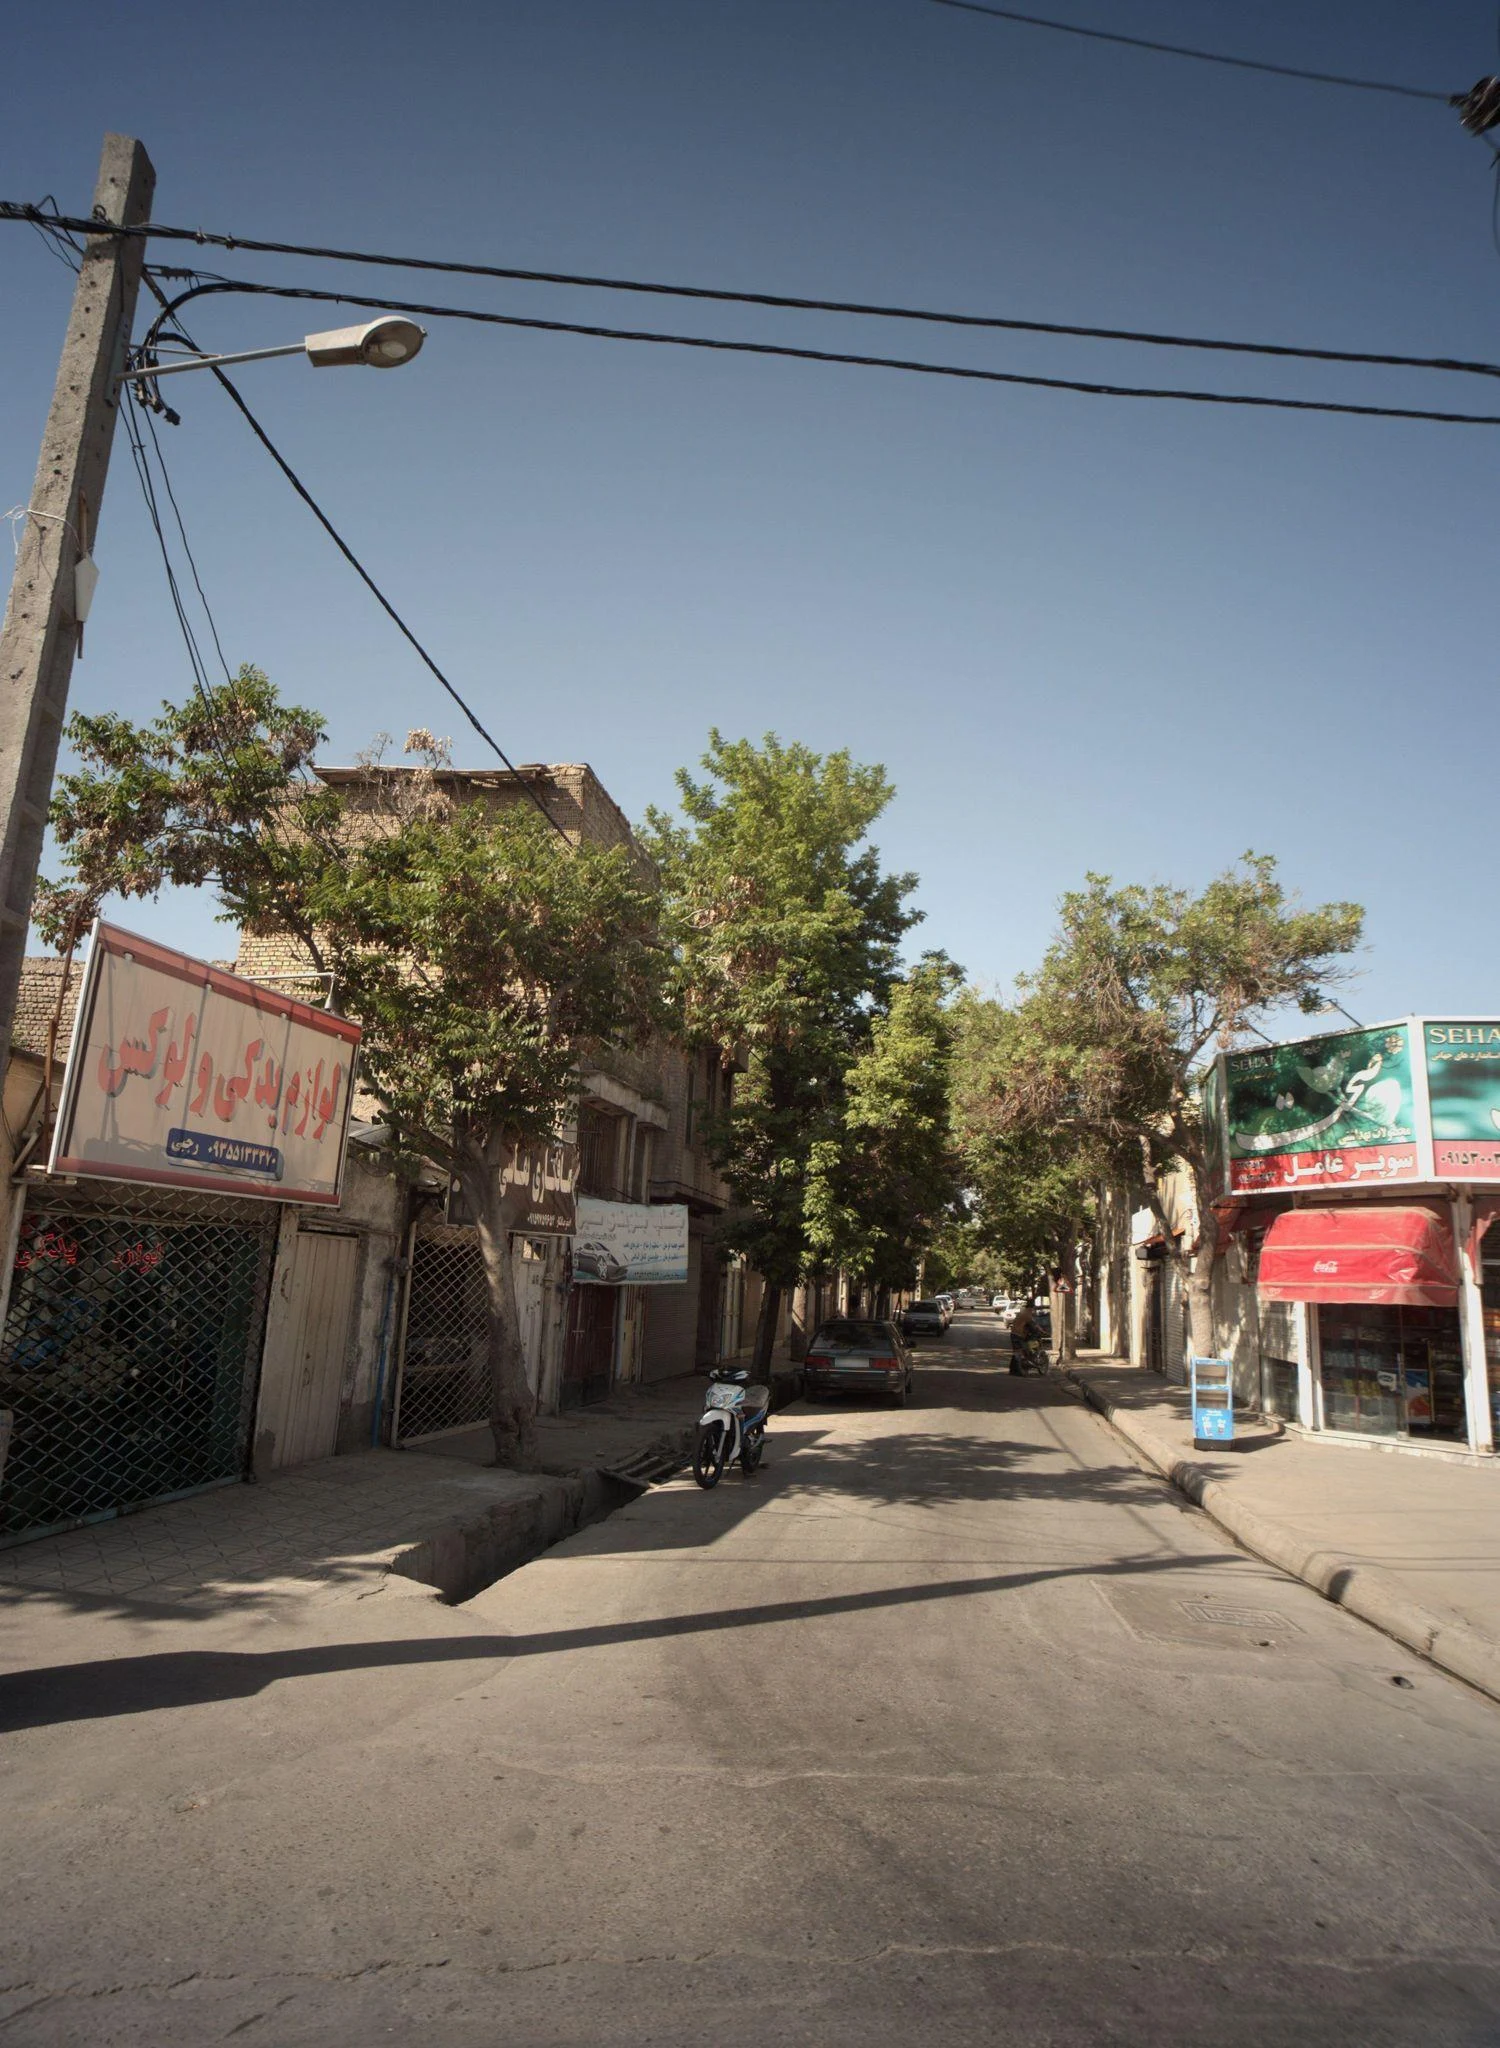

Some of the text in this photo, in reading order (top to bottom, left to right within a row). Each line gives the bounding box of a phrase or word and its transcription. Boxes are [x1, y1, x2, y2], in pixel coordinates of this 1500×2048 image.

[98, 1006, 194, 1106] لوکس
[189, 1051, 211, 1114] و
[281, 1057, 341, 1140] لوازم
[1284, 1153, 1344, 1183] عامل
[1350, 1154, 1414, 1179] سوپر
